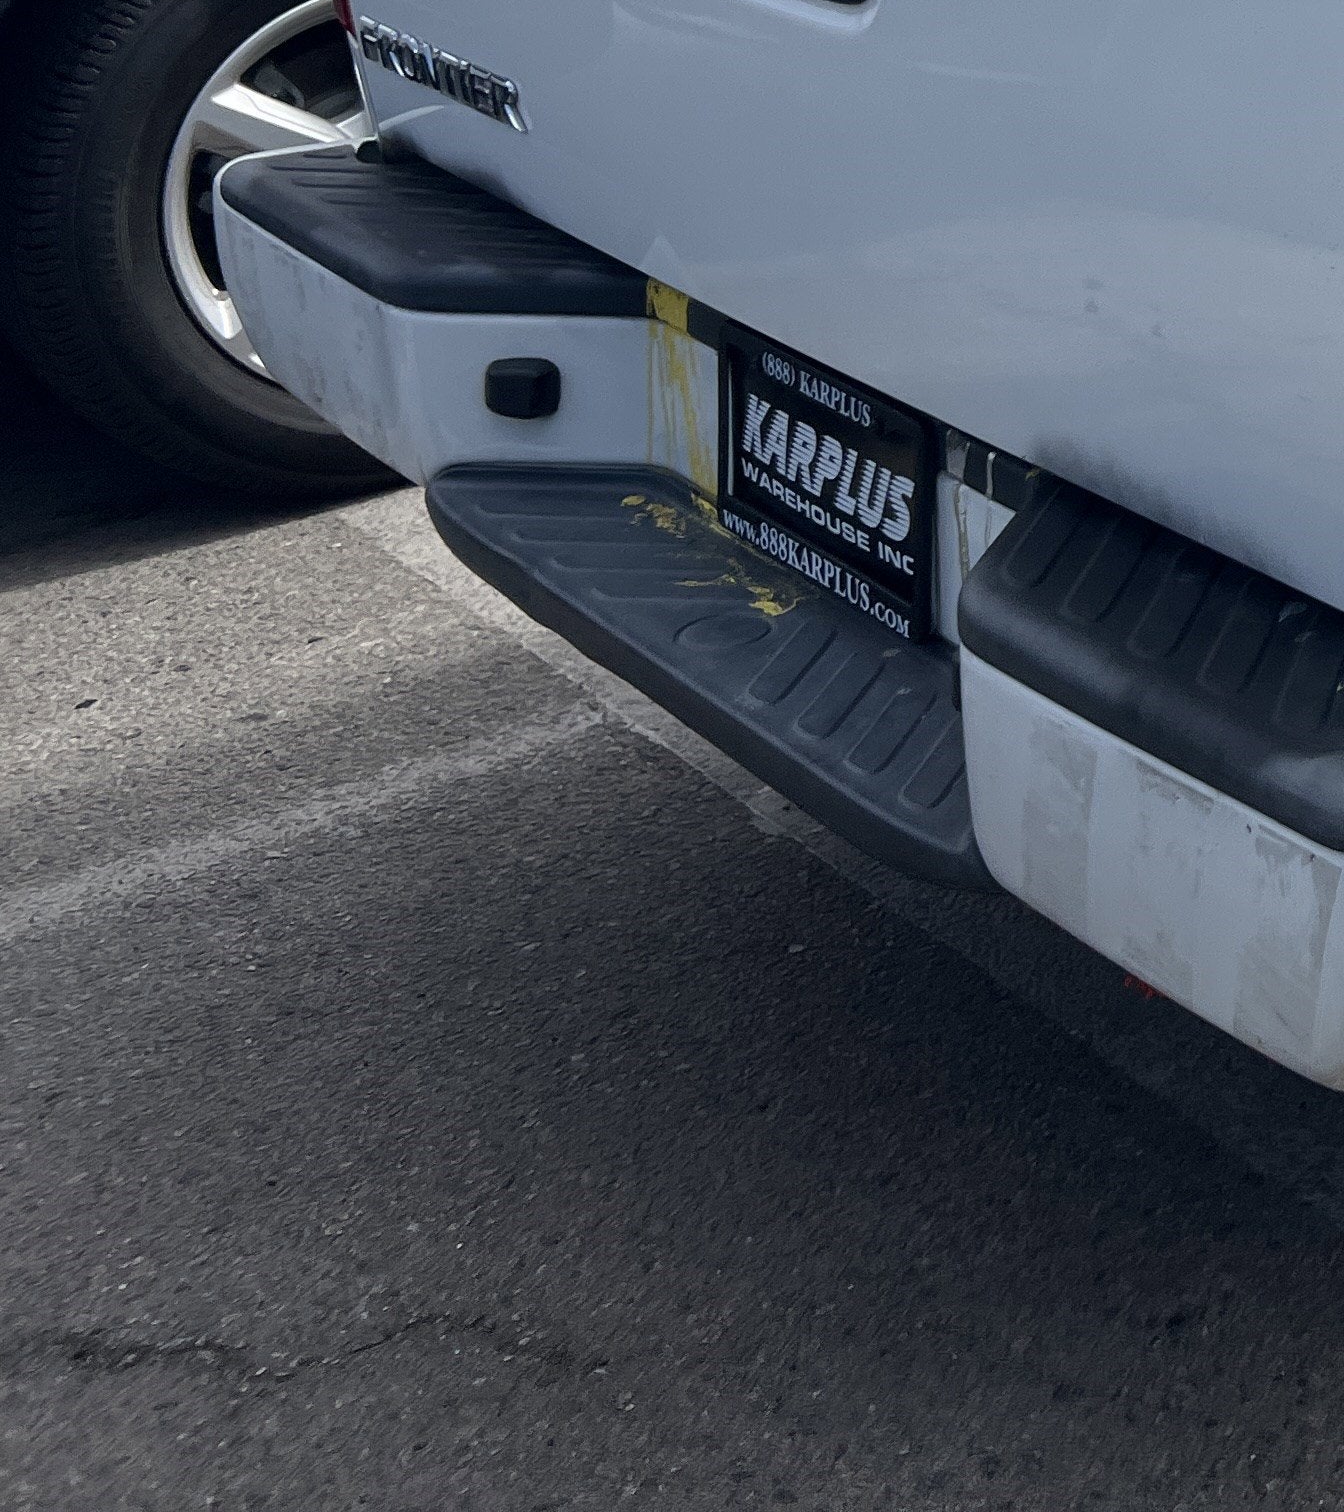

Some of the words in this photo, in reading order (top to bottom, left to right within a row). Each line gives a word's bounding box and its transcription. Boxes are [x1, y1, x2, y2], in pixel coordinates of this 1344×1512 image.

[359, 15, 528, 135] FRONTIER
[762, 351, 796, 387] (888)
[799, 370, 873, 428] KARPLUS
[741, 457, 871, 552] WAREHOUSE
[877, 540, 915, 576] INC
[742, 393, 916, 542] KARPLUS
